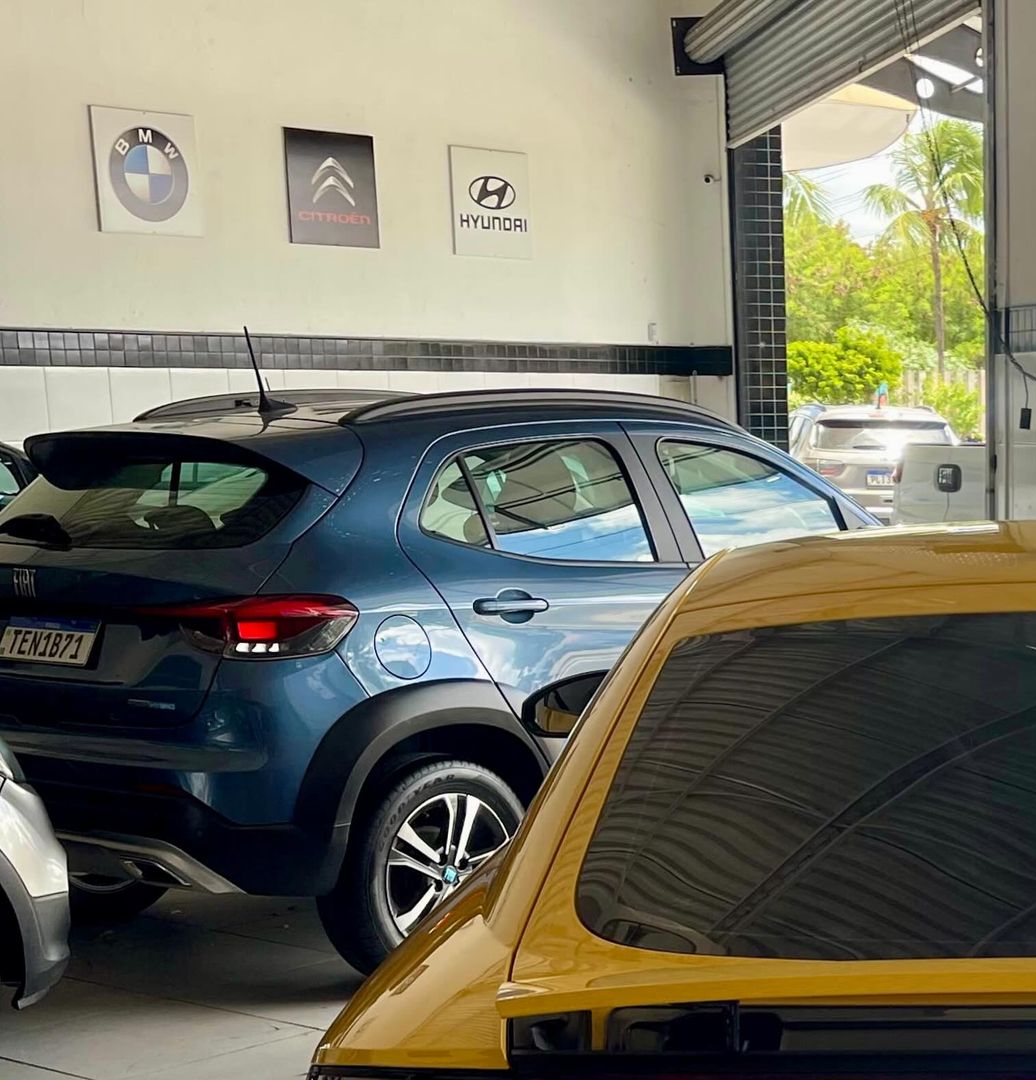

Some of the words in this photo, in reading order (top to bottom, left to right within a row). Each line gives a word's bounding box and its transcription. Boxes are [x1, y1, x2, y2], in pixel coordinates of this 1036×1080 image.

[114, 128, 179, 160] BMW
[460, 213, 527, 233] HYUNDAI
[13, 568, 36, 598] FIAT
[9, 629, 84, 659] TEN1B71
